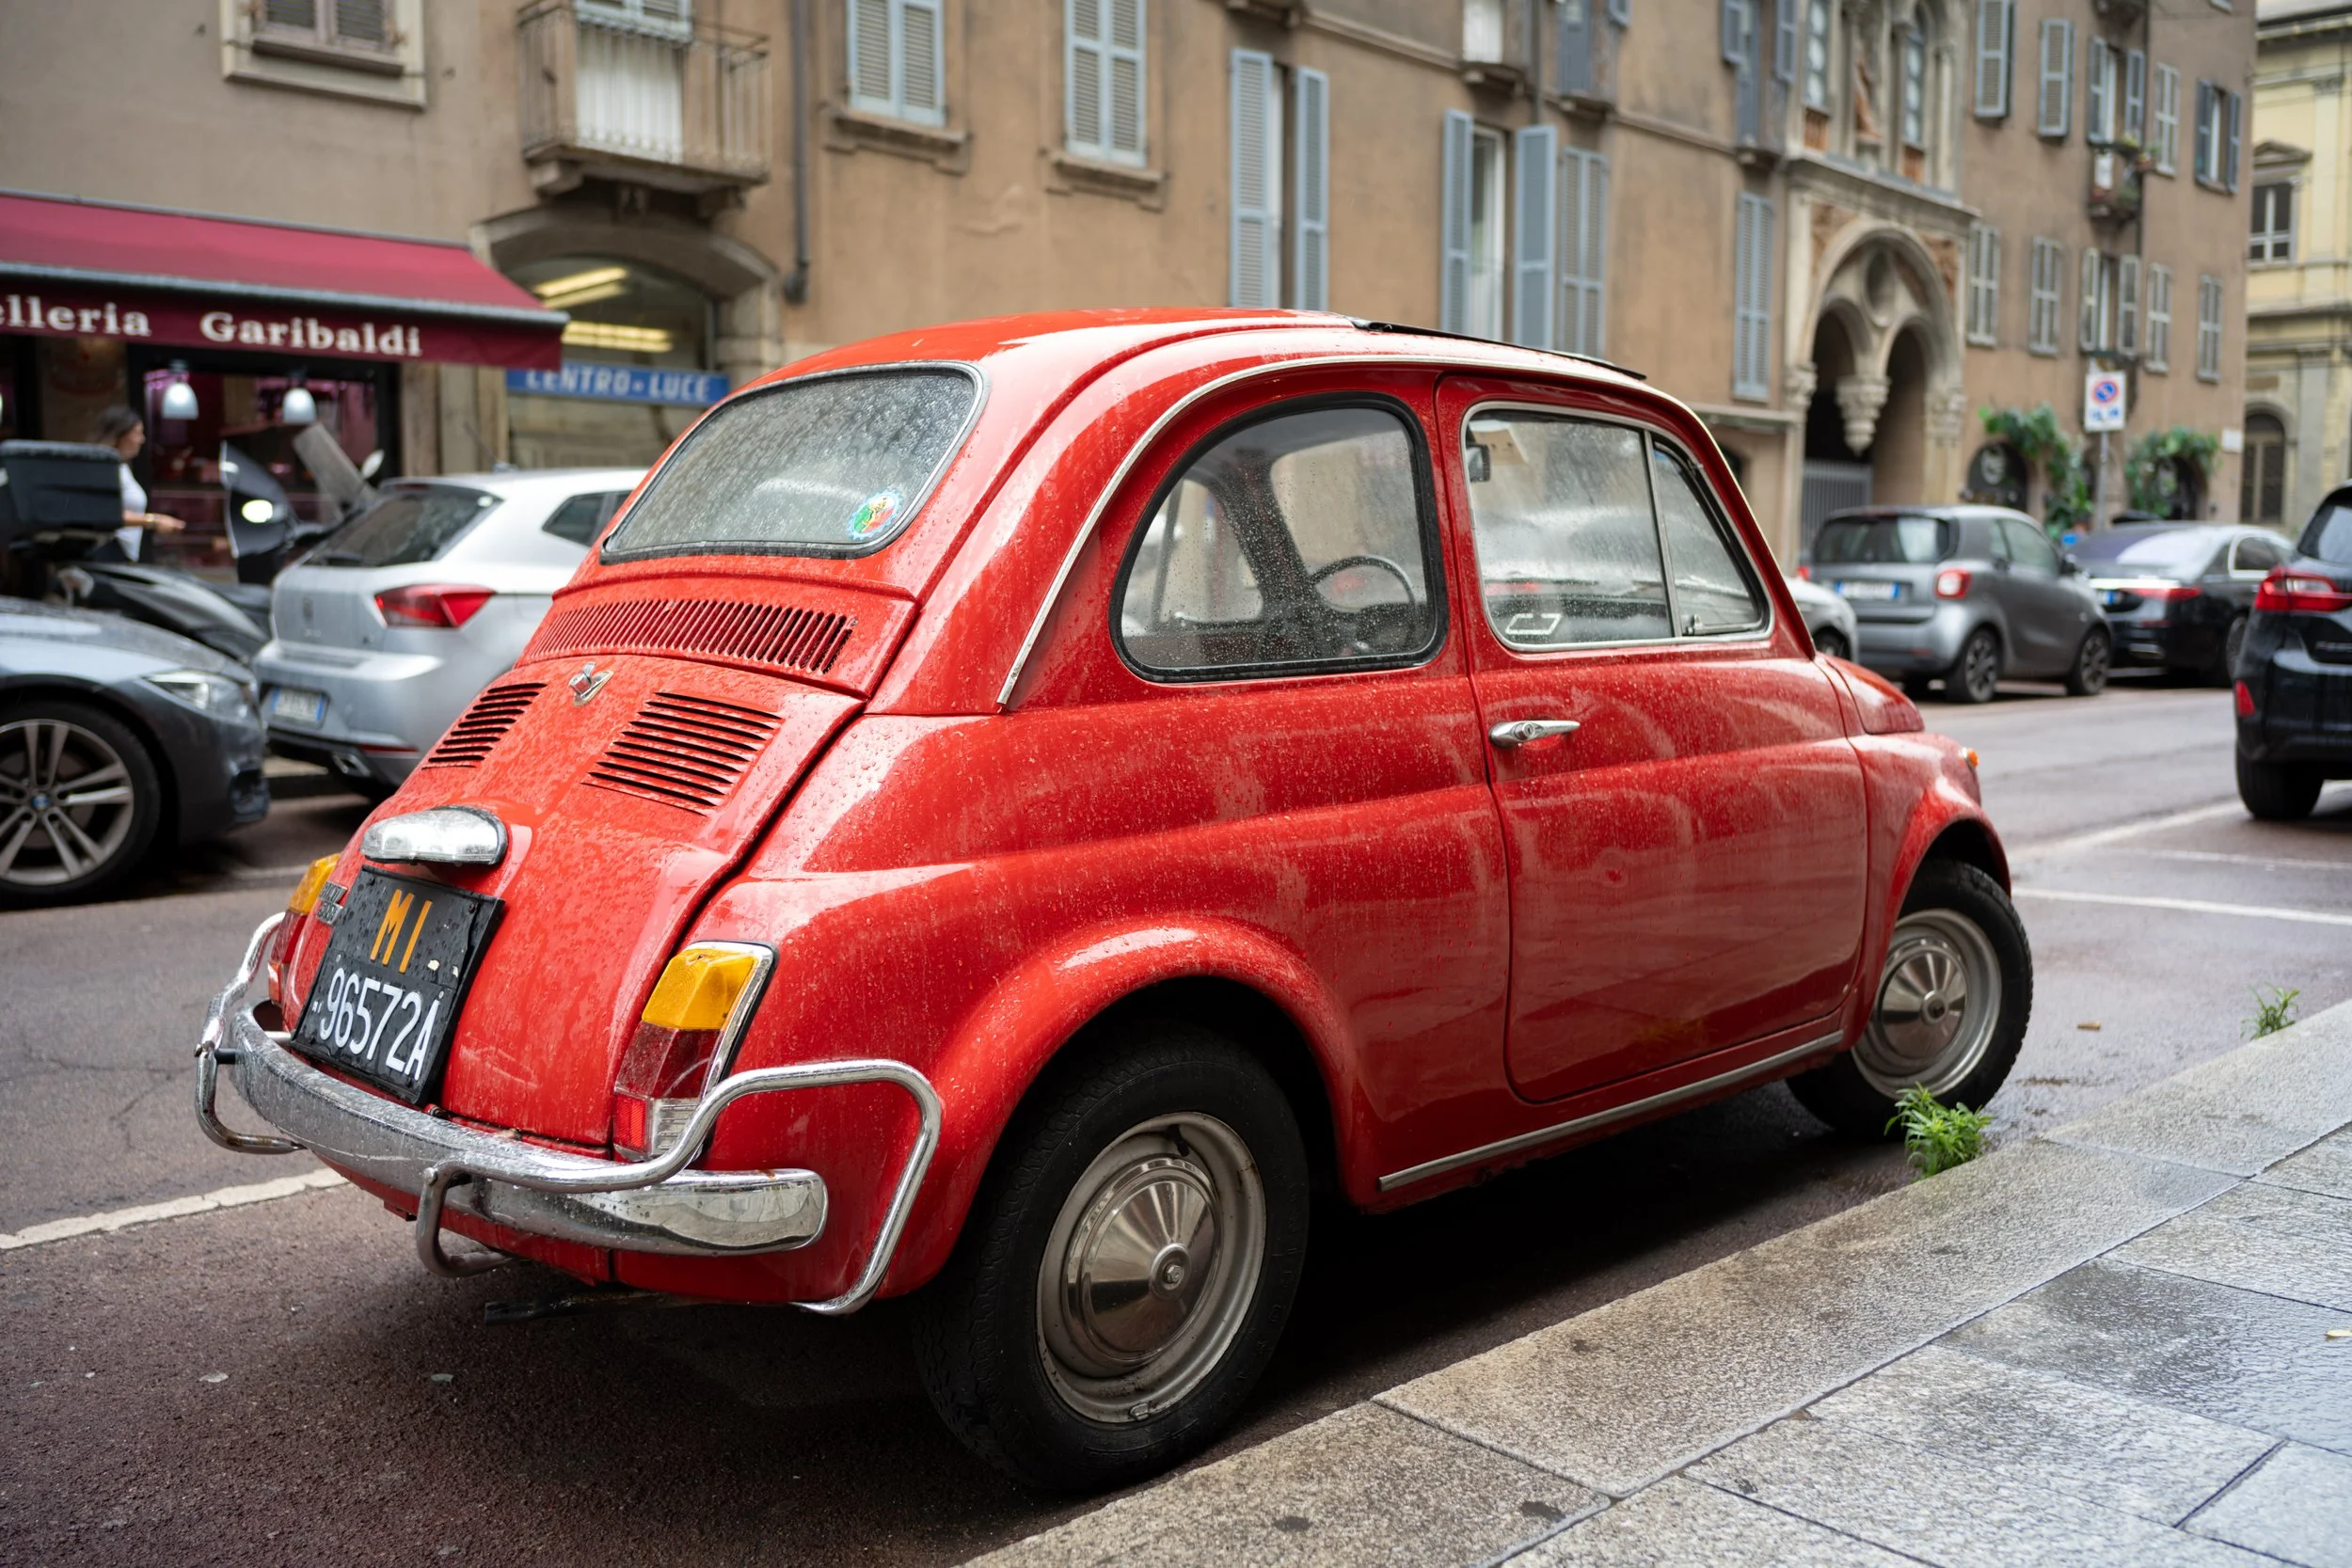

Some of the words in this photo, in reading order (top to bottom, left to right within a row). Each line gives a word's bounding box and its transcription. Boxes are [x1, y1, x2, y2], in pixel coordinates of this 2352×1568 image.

[0, 293, 151, 337] lleria
[199, 311, 422, 356] Garibaldi
[370, 889, 433, 973] MI
[320, 967, 440, 1081] 96572A
